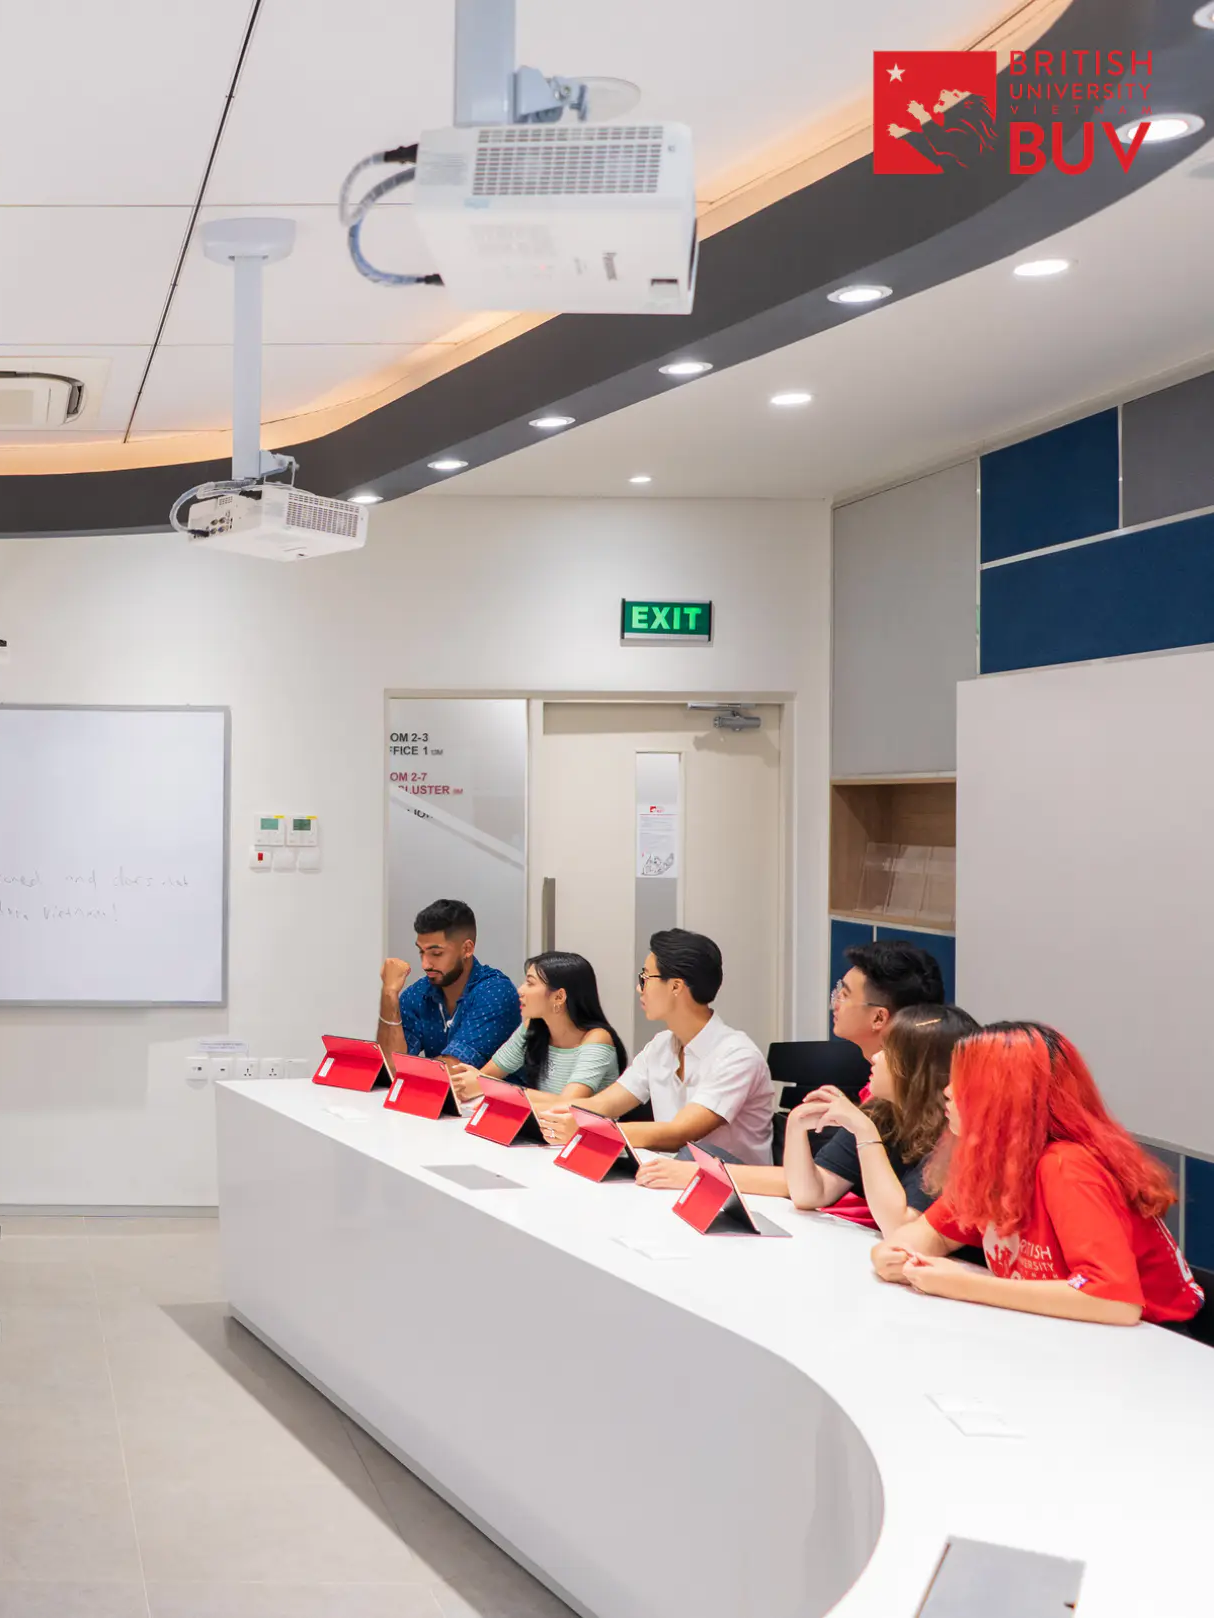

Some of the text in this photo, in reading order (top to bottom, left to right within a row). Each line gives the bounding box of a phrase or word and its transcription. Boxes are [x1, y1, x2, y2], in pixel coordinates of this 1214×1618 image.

[631, 606, 702, 630] EXIT
[411, 732, 429, 742] 2-3
[423, 745, 428, 755] 1
[411, 772, 427, 781] 2-7
